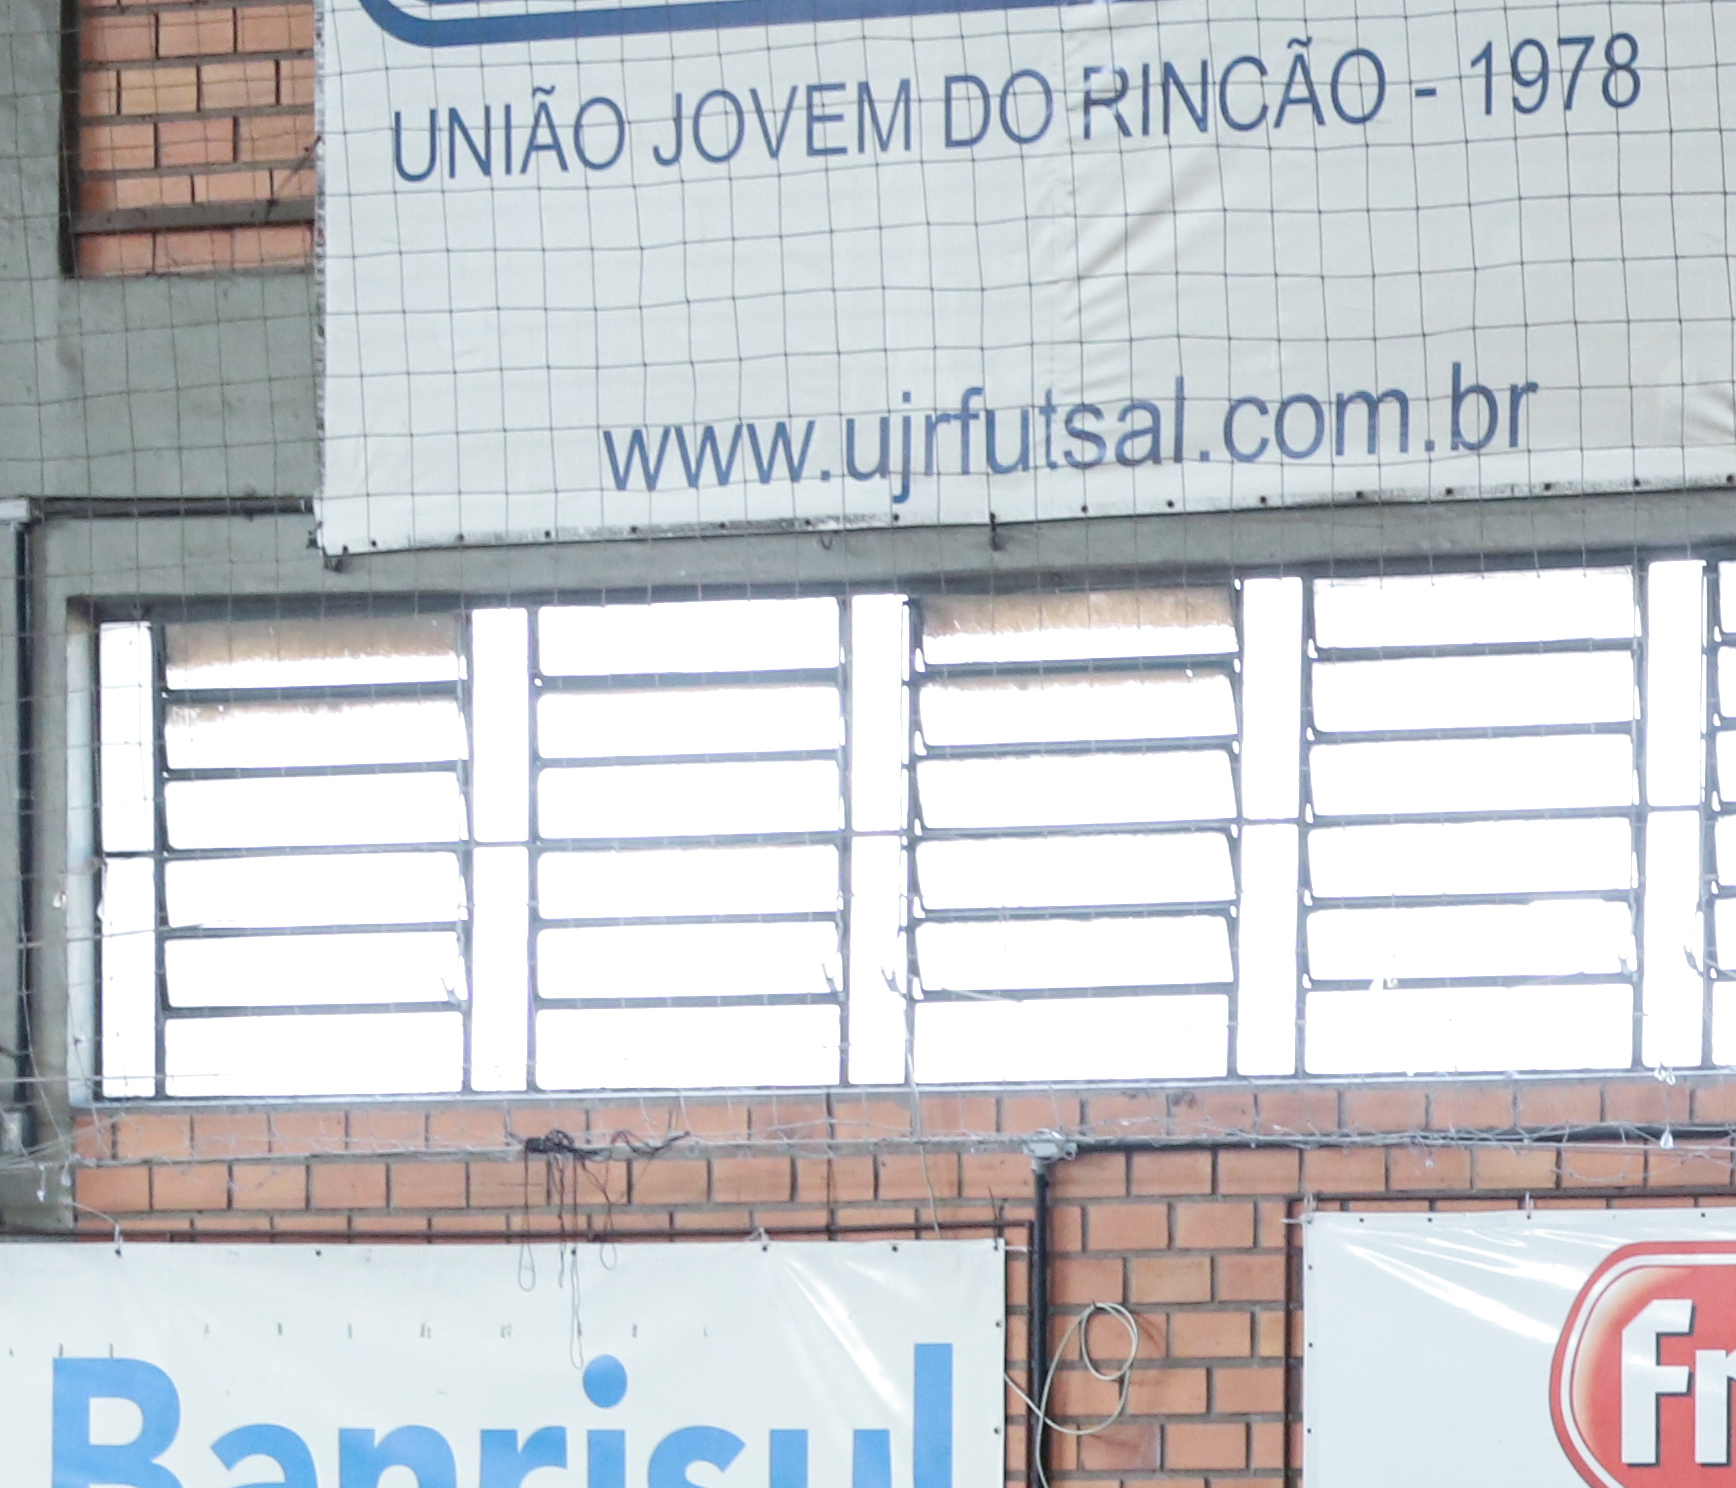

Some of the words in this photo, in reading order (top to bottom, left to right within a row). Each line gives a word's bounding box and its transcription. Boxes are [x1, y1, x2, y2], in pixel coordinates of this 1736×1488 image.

[394, 86, 627, 183] UNIÃO
[652, 78, 912, 167] JOVEM
[943, 69, 1053, 149] DO
[1082, 36, 1387, 140] RINCÃO
[1470, 33, 1641, 116] 1978
[603, 361, 1538, 504] www.ujrfutsal.com.br
